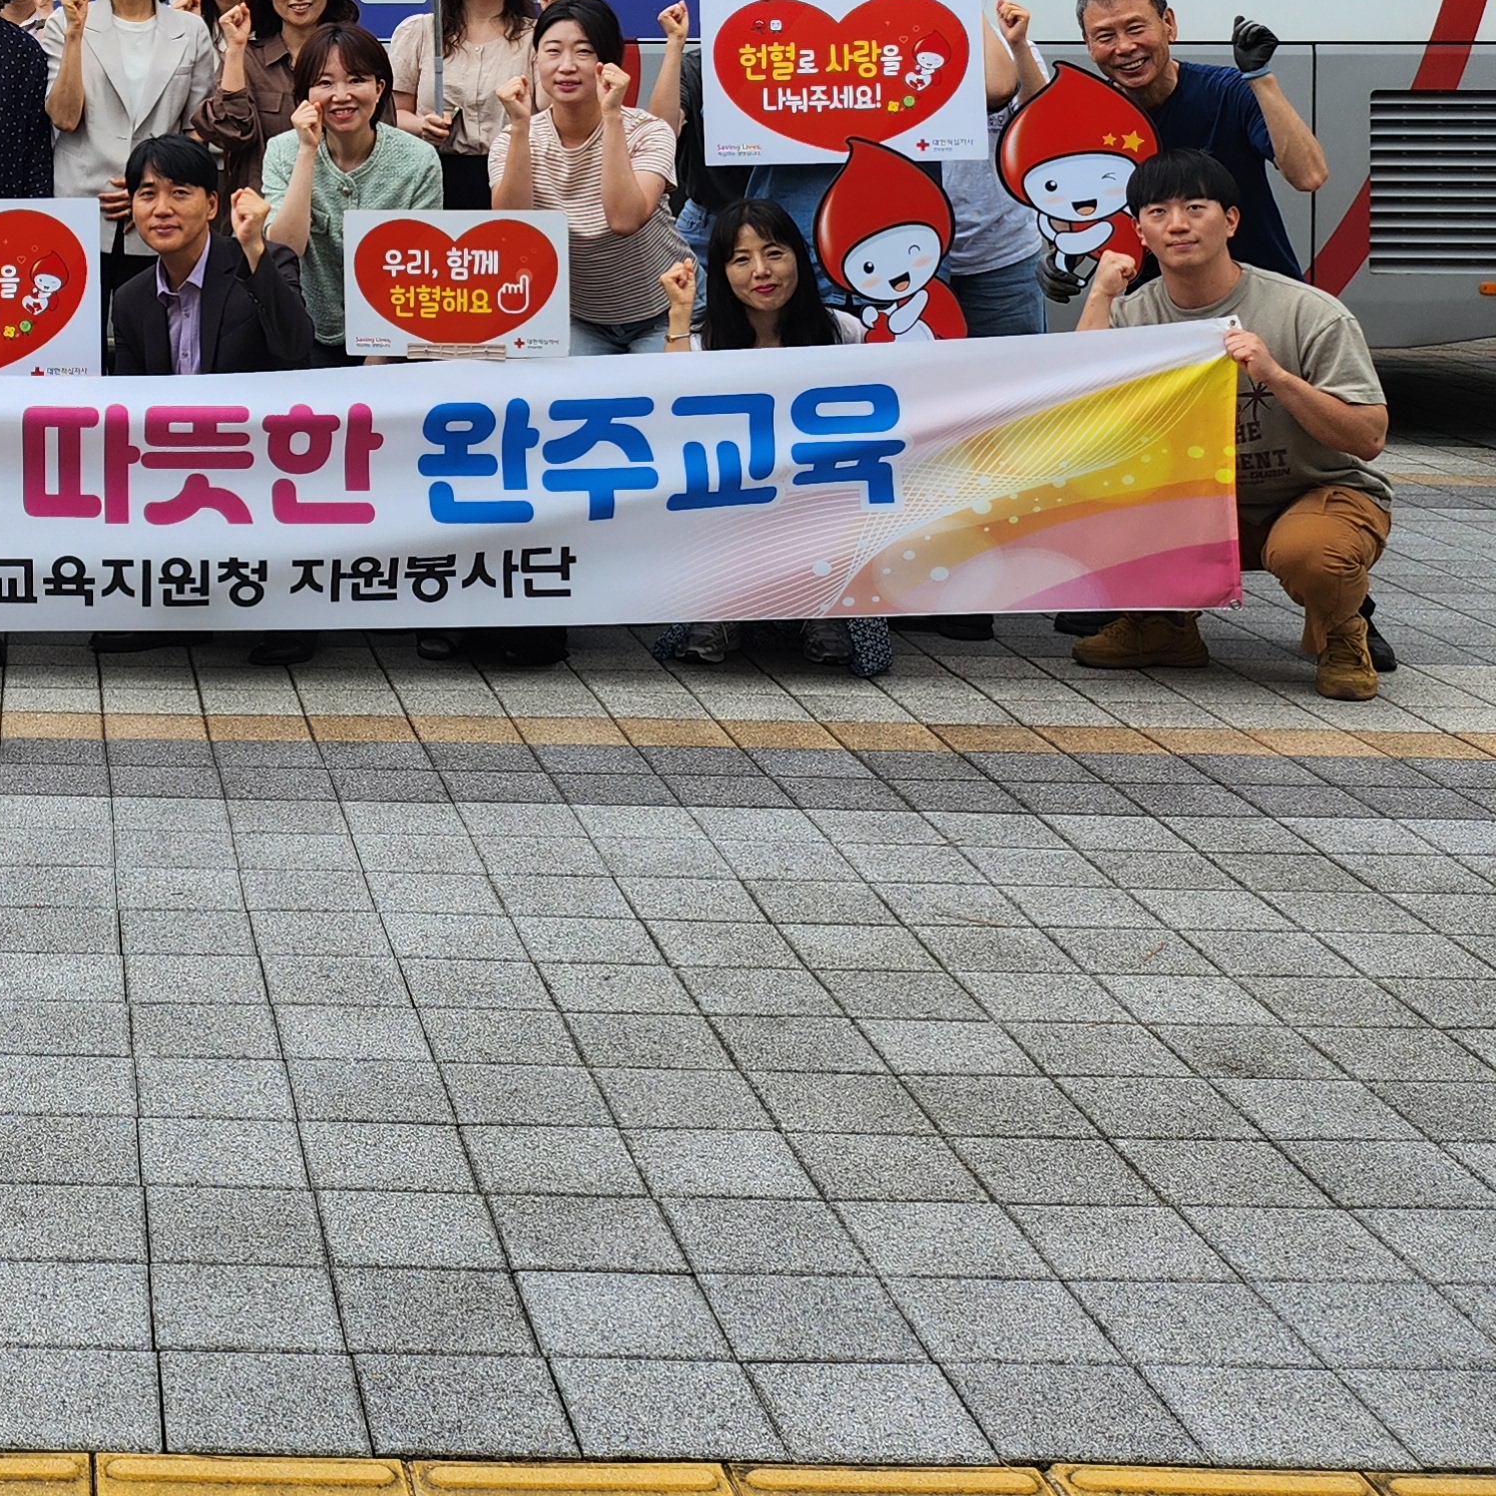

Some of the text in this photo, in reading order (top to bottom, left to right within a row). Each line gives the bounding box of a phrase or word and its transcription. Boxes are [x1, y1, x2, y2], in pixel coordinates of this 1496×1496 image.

[738, 39, 903, 82] 헌혈로 사랑을
[762, 82, 882, 114] 나눠주세요!
[382, 247, 499, 281] 우리, 함께
[390, 284, 493, 318] 헌혈해요
[22, 403, 385, 526] 따뜻한
[417, 383, 906, 524] 완주교육
[289, 545, 578, 603] 자원봉사단
